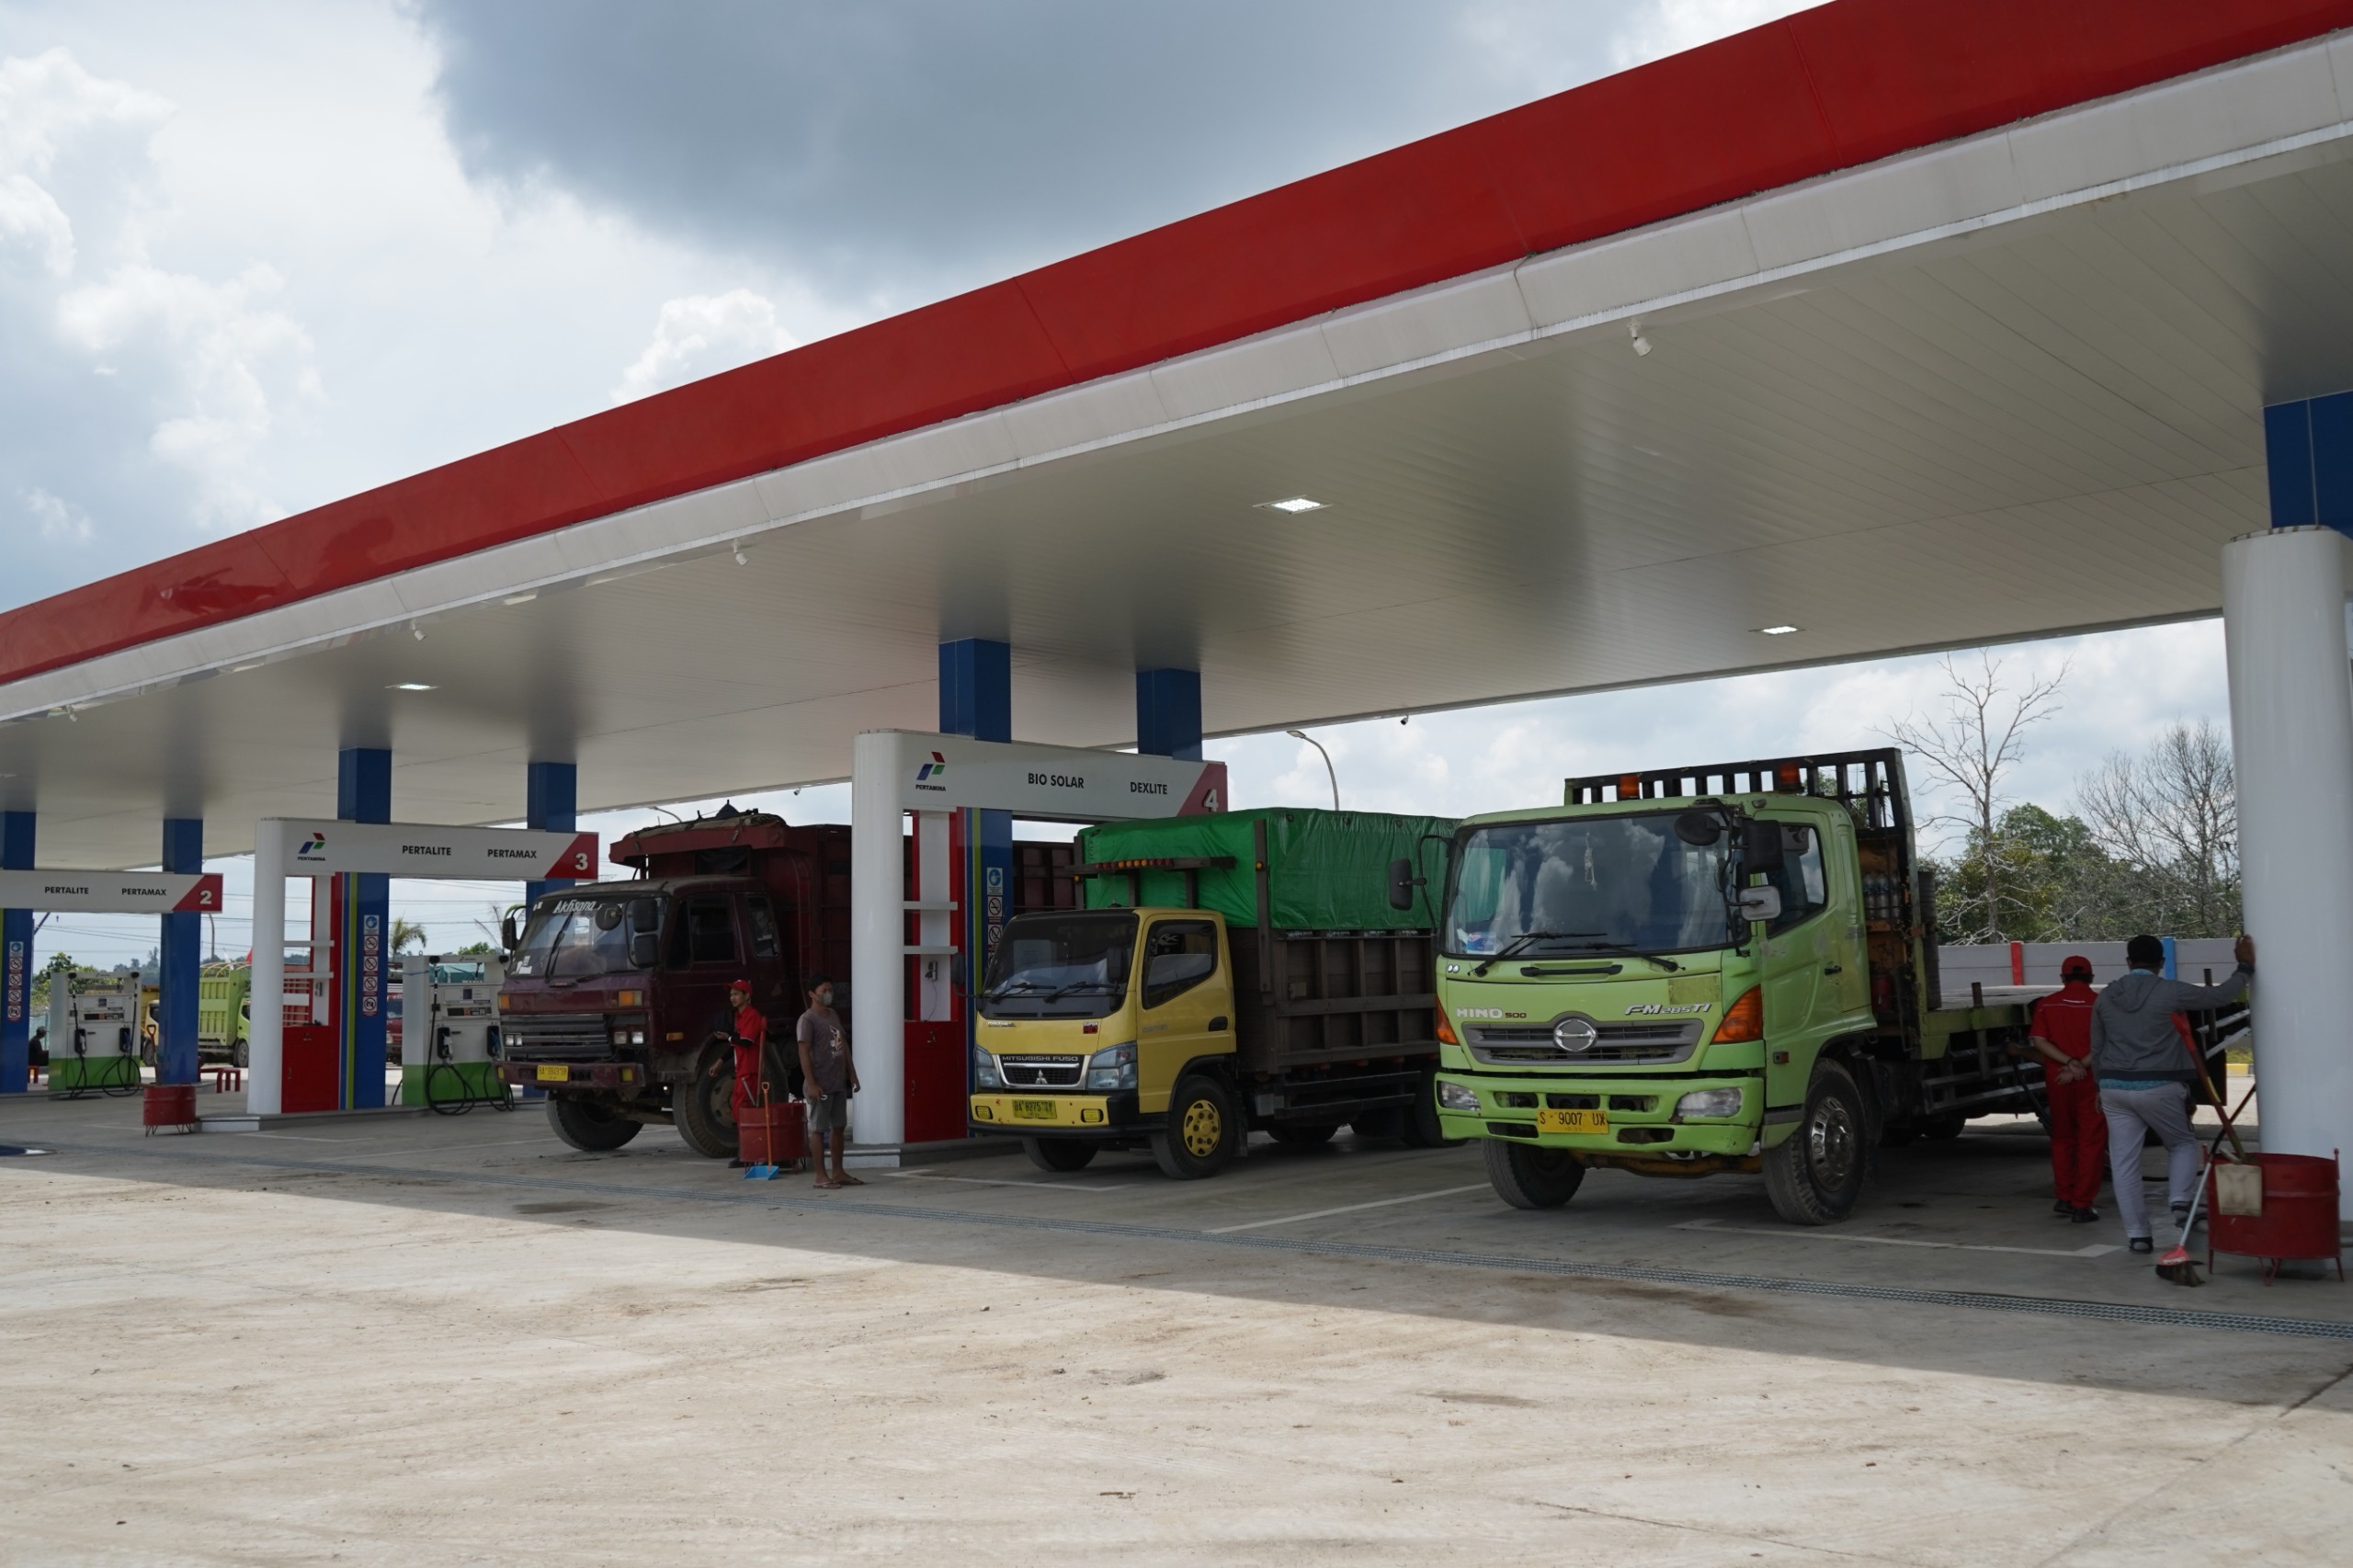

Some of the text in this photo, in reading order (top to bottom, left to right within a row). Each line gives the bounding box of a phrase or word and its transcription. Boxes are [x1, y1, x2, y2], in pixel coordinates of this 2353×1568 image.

[1028, 772, 1085, 789] BIO SOLAR
[1130, 781, 1168, 795] DEXLITE
[1203, 789, 1219, 812] 4
[402, 845, 452, 857] PERTALITE
[487, 848, 537, 859] PERTAMAX
[574, 852, 588, 870] 3
[44, 886, 89, 895] PERTALITE
[121, 888, 167, 897] PERTAMAX
[199, 890, 212, 905] 2
[1456, 1007, 1503, 1019] HINO
[1540, 1111, 1606, 1125] S 9007 UX
